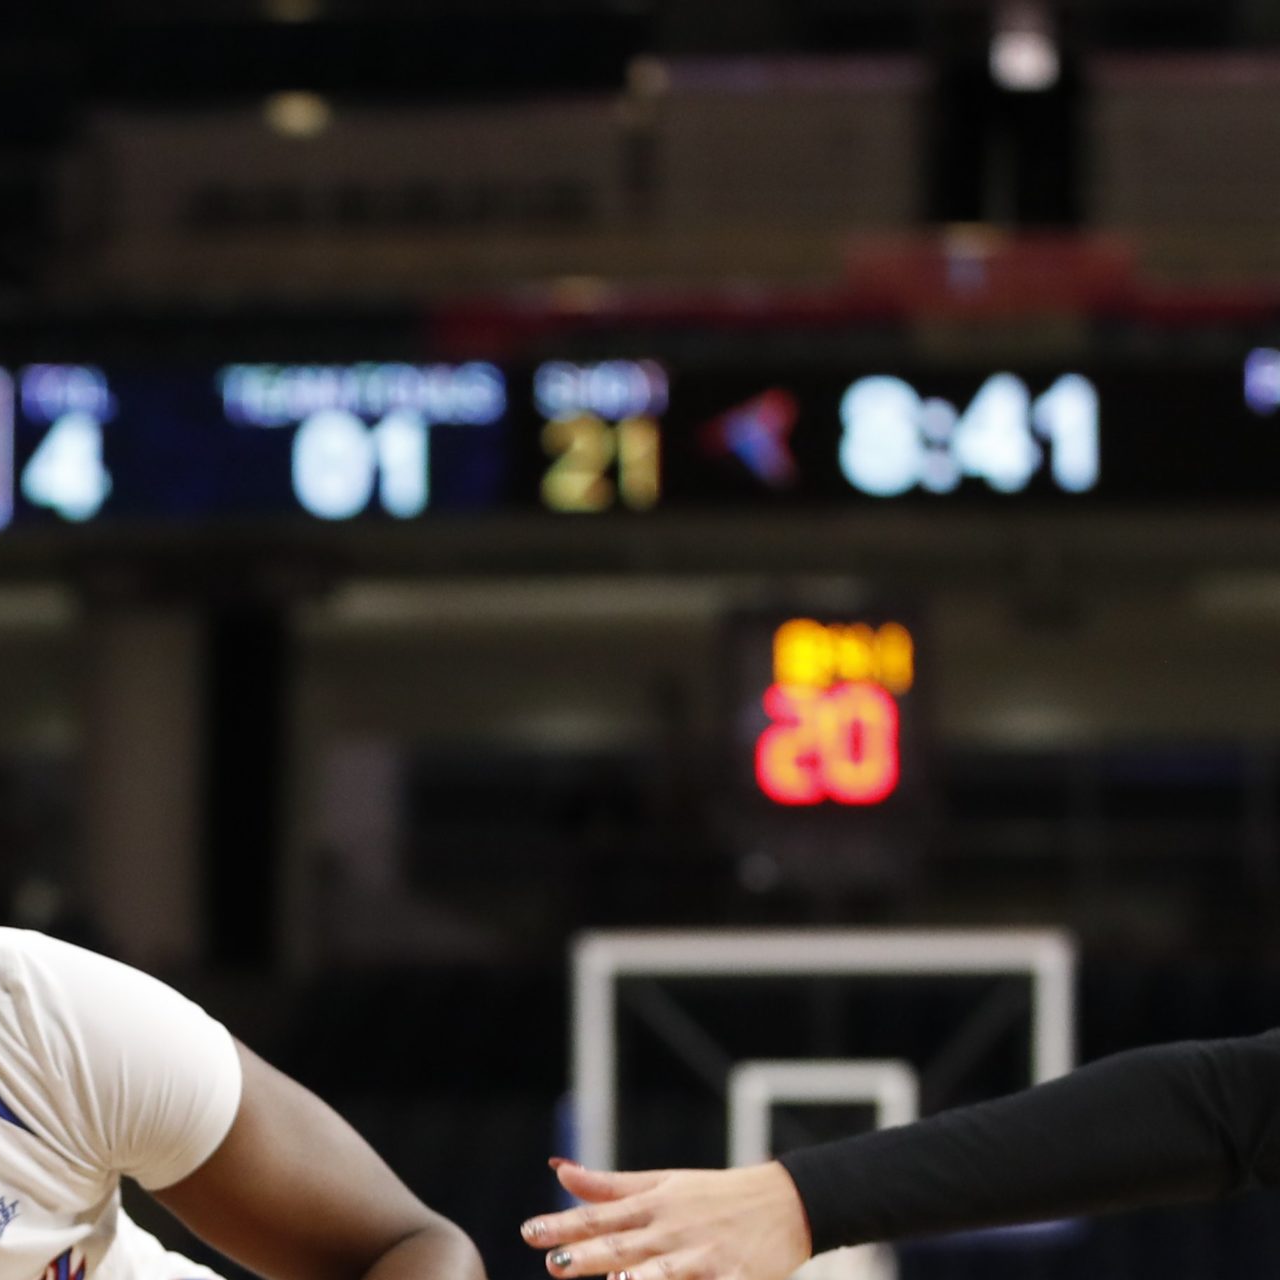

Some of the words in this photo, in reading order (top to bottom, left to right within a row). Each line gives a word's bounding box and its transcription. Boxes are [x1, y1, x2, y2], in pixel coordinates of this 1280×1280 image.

[21, 411, 112, 523] 4
[540, 412, 660, 513] 21
[839, 371, 1100, 497] 8:41
